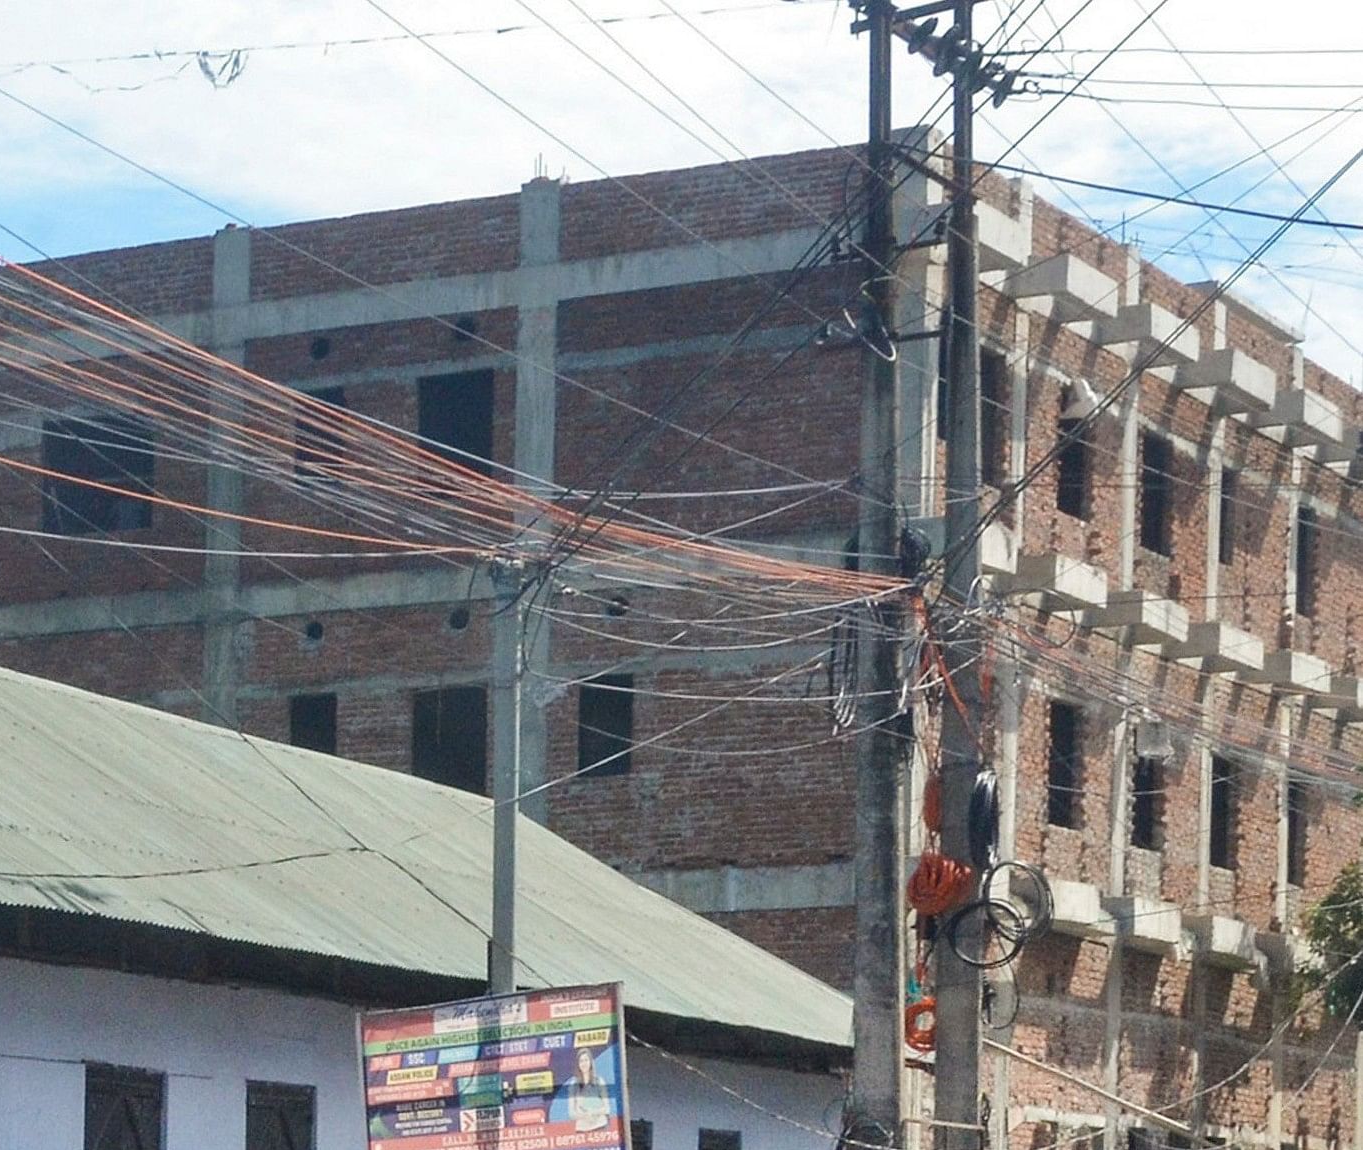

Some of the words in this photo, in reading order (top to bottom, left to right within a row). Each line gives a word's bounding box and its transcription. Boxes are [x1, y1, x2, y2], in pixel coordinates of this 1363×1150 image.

[386, 1038, 409, 1051] ONCE
[411, 1035, 440, 1048] AGAIN
[548, 1020, 573, 1031] INDIA
